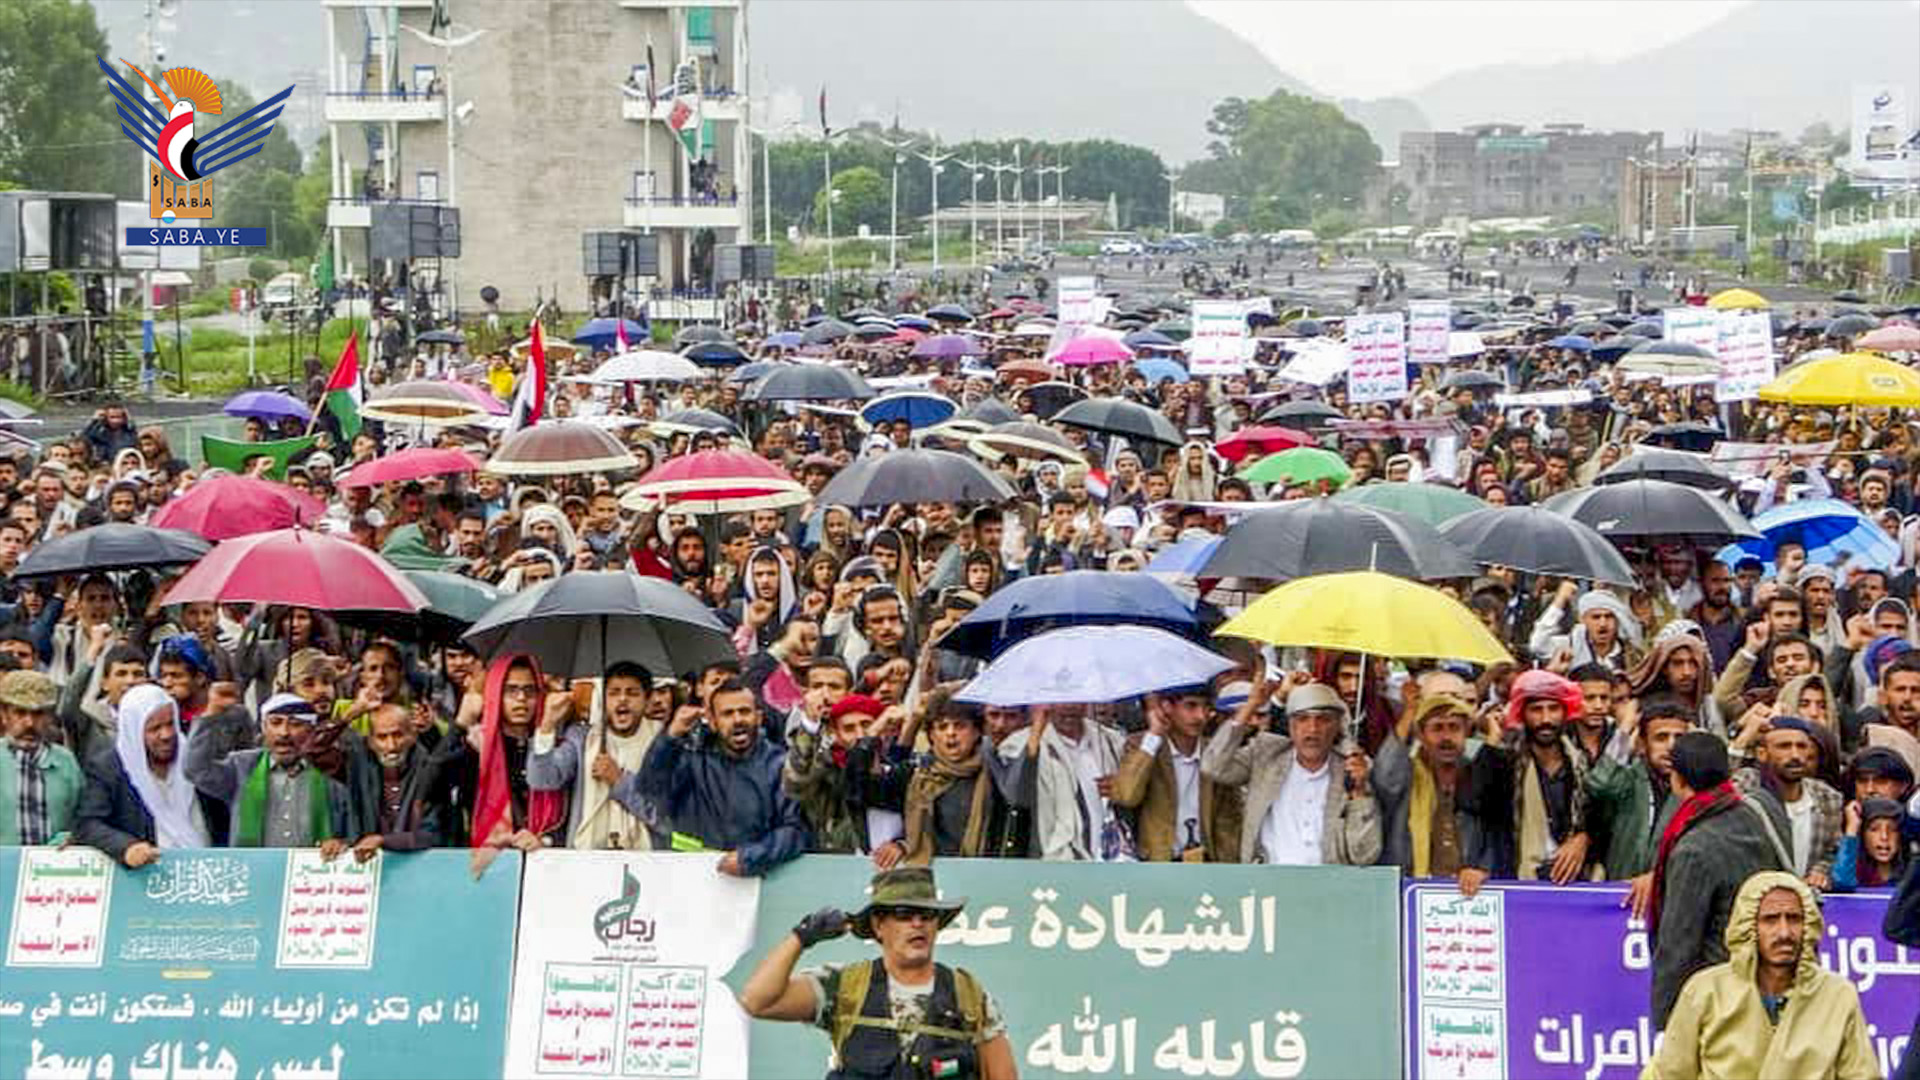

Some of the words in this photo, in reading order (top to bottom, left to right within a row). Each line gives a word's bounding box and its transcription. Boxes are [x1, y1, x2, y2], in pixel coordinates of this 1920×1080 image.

[1030, 887, 1276, 967] الشهادة
[31, 992, 61, 1027] في
[112, 993, 195, 1023] فستكون
[218, 994, 254, 1018] الله
[331, 997, 359, 1025] من
[418, 998, 444, 1028] لم
[454, 996, 479, 1030] إذا
[1027, 995, 1137, 1076] الله
